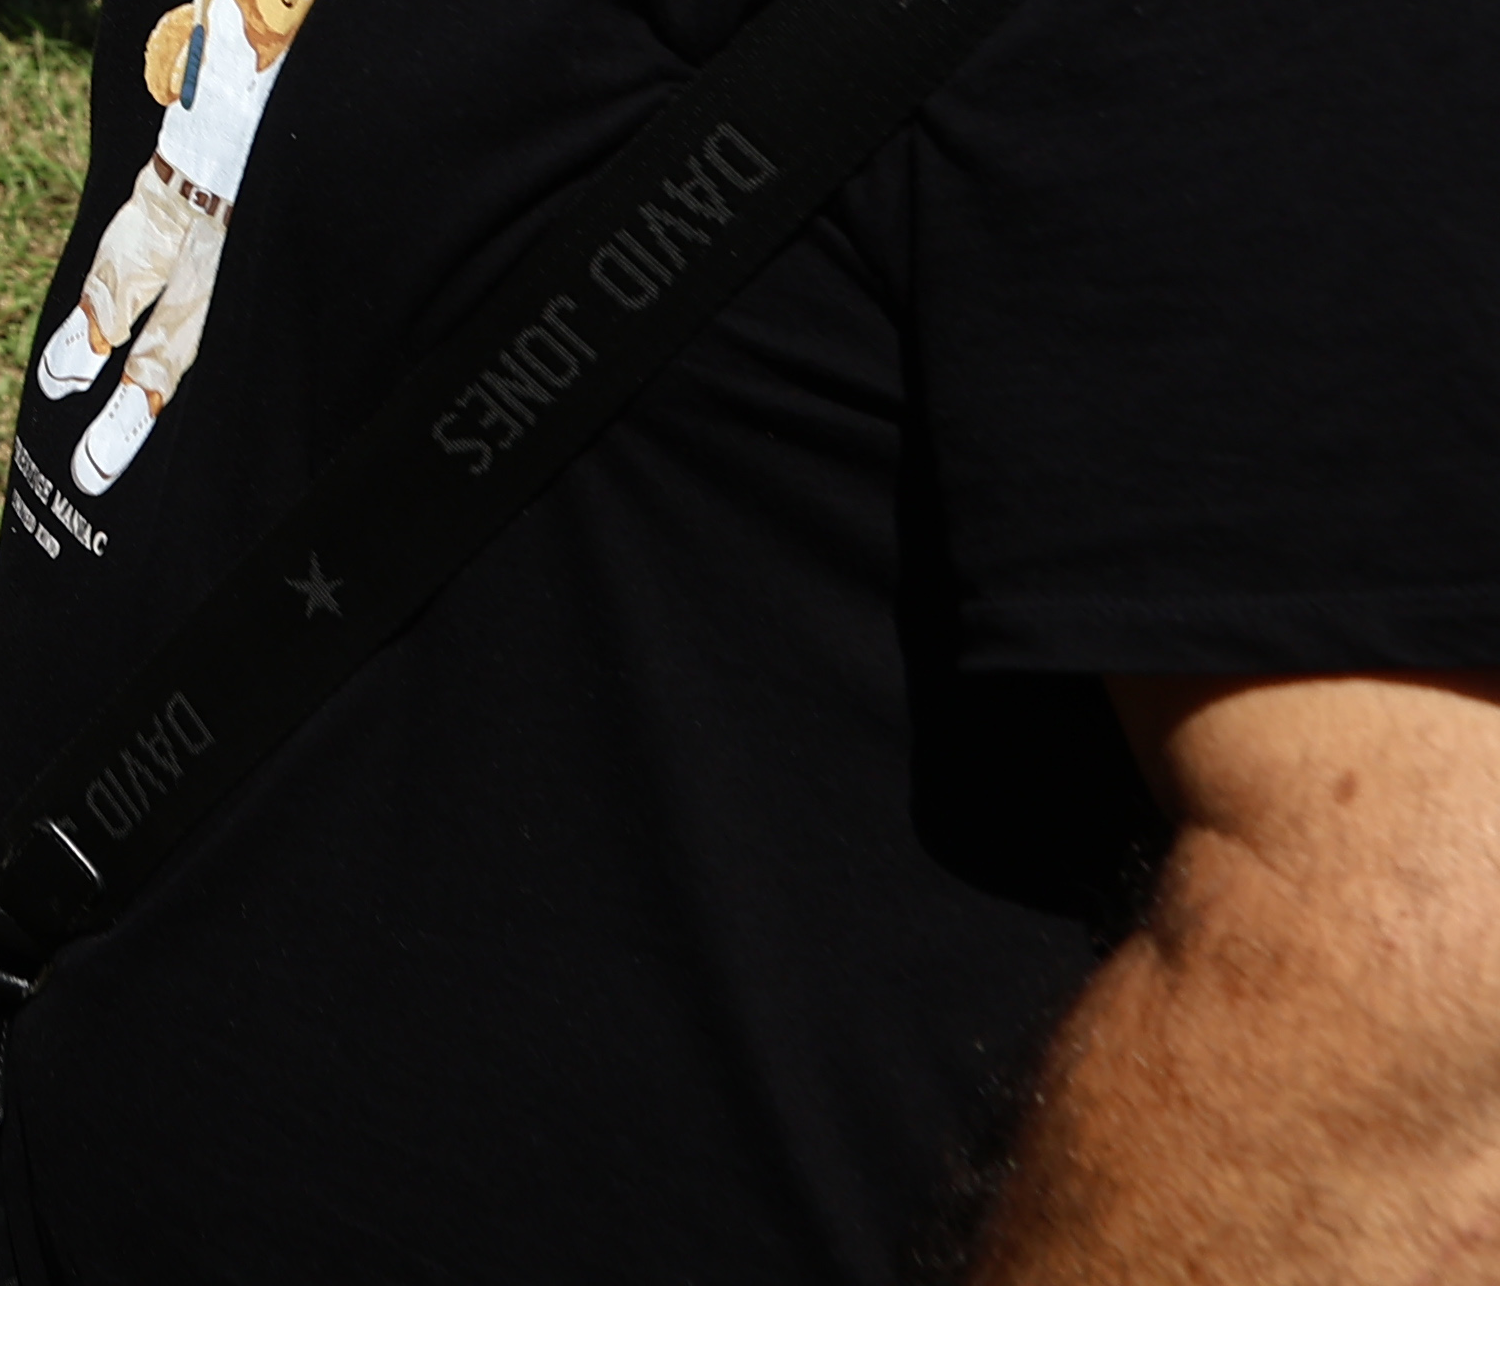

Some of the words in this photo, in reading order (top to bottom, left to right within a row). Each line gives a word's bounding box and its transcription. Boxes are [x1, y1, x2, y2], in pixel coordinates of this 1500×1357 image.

[588, 121, 780, 313] DAVID
[431, 293, 599, 477] JONES
[85, 689, 217, 840] DAVID
